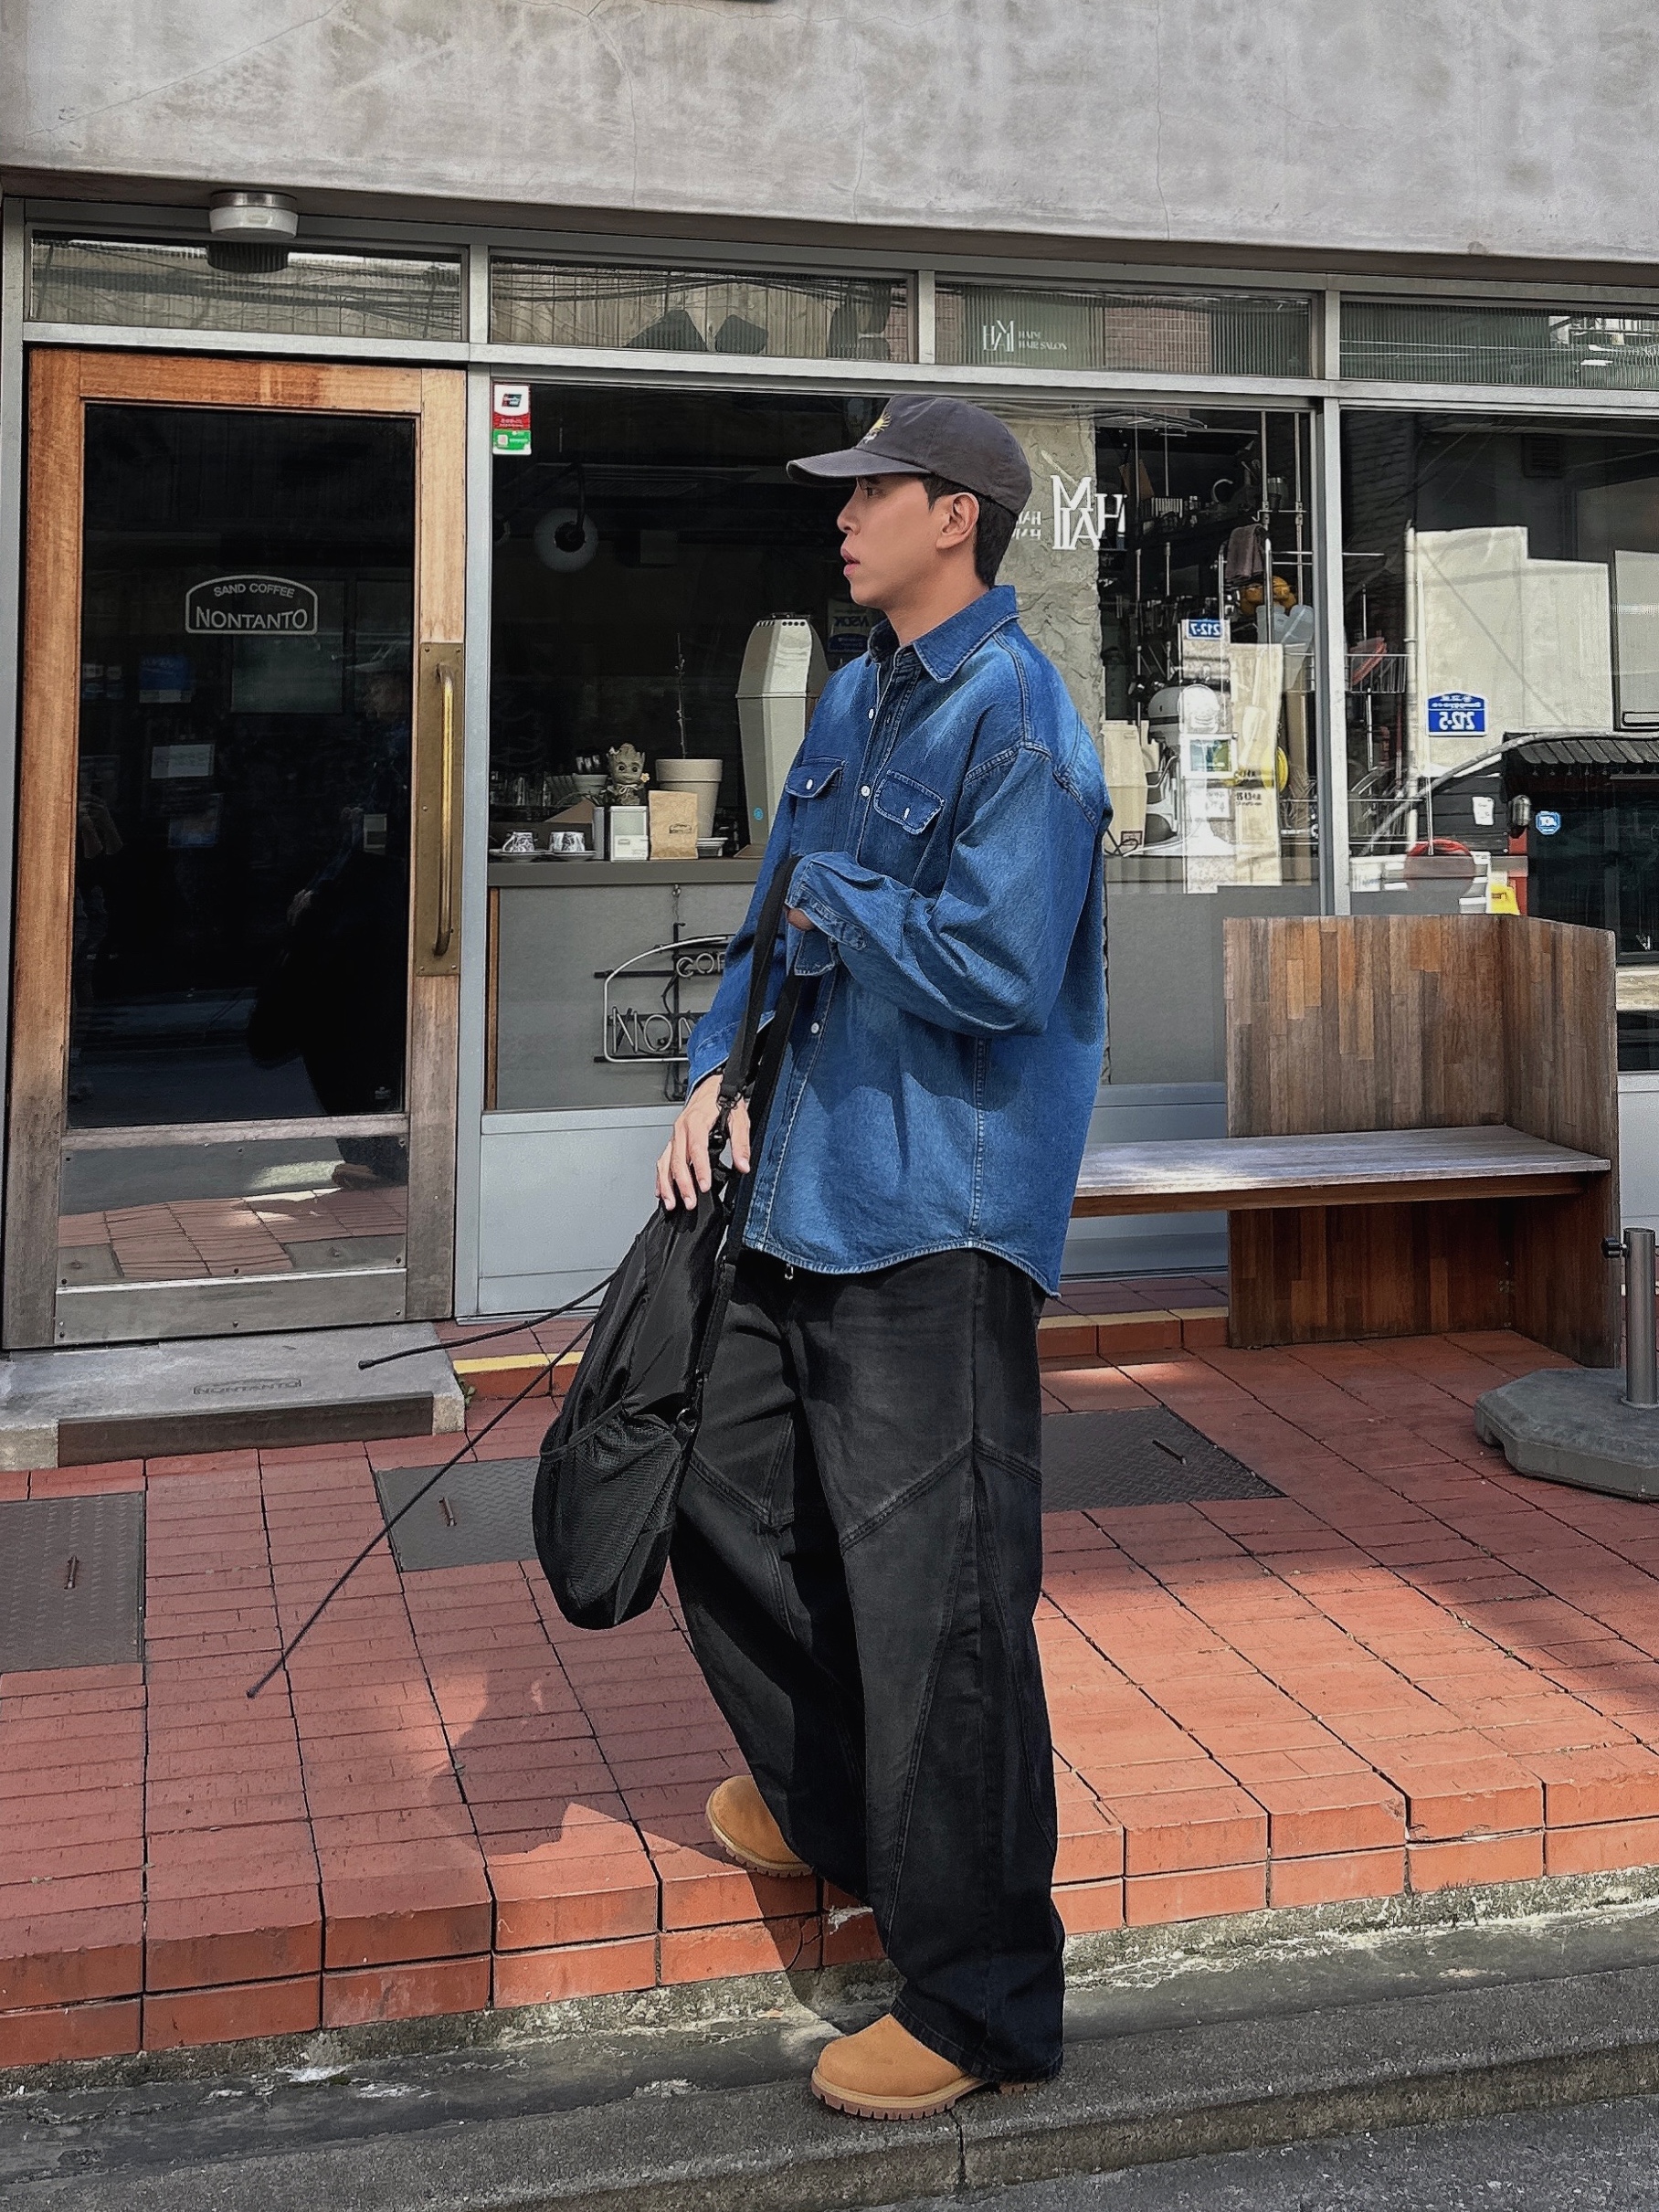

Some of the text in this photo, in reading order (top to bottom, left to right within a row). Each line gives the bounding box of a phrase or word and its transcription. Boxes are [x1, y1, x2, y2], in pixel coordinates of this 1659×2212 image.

[1040, 342, 1067, 350] SALON
[214, 583, 295, 598] SAND COFFEE
[195, 606, 308, 629] NONTANTO
[676, 952, 727, 977] COF
